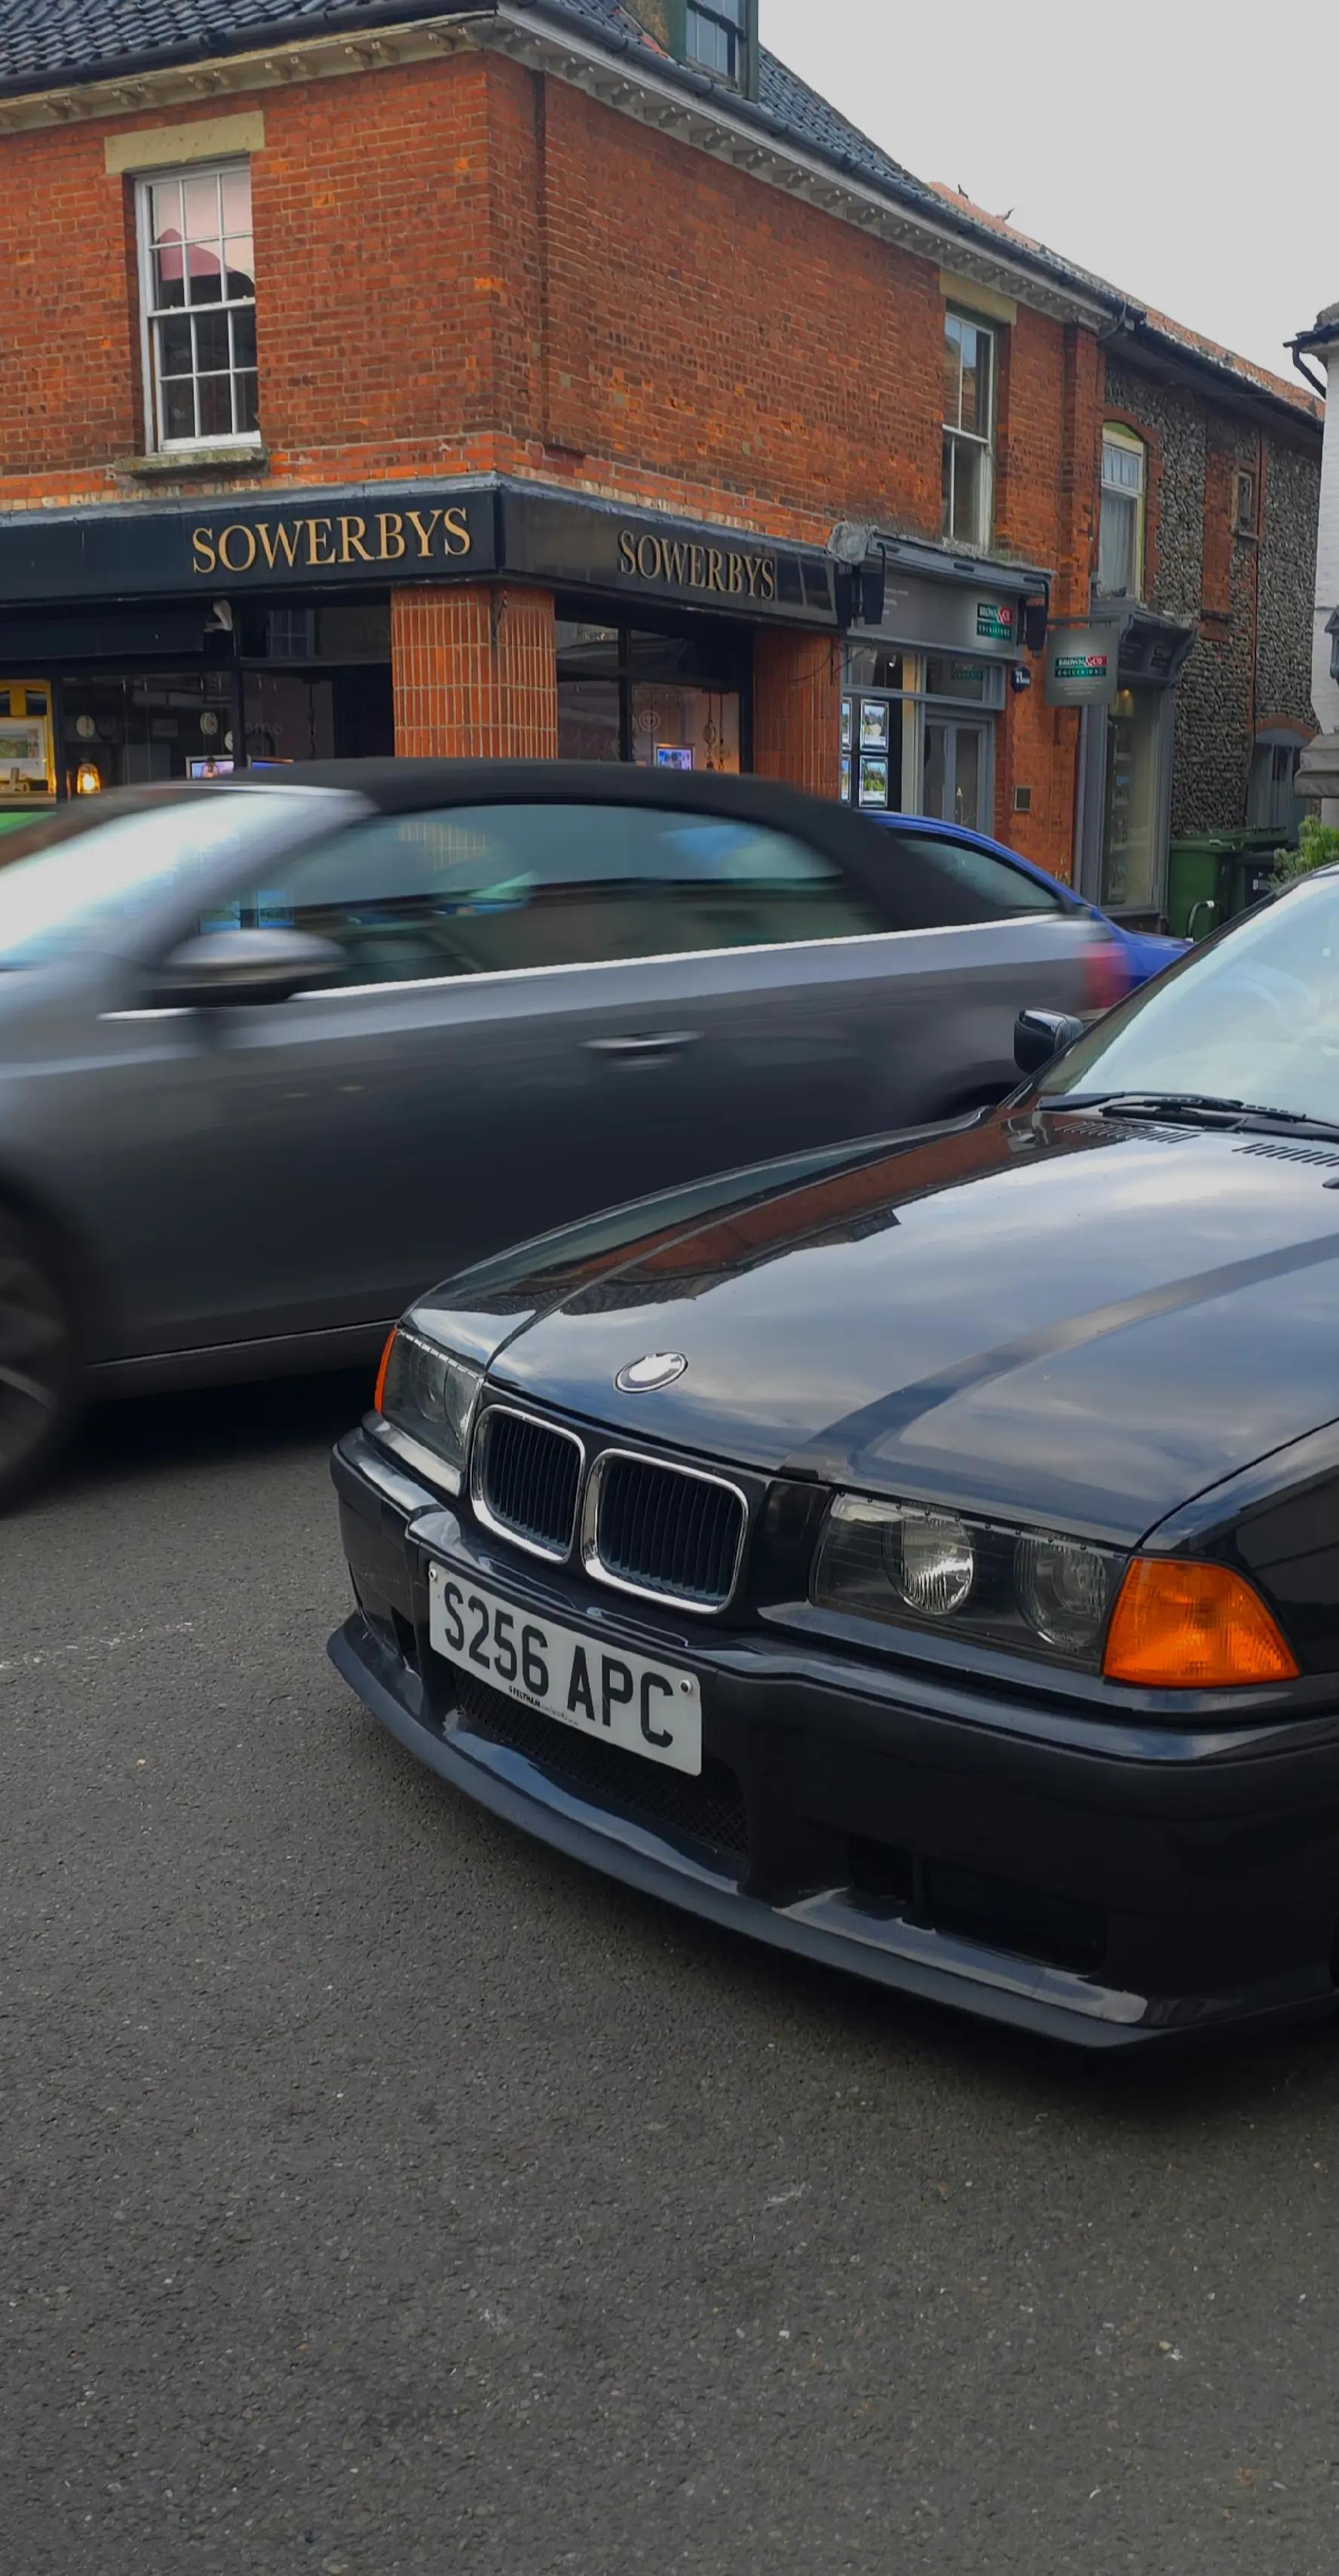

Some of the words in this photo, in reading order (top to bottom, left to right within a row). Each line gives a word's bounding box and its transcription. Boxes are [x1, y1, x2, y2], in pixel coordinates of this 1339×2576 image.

[192, 507, 471, 574] SOWERBYS
[619, 529, 775, 600] SOWERBYS
[444, 1581, 550, 1697] S256
[567, 1645, 674, 1748] APC
